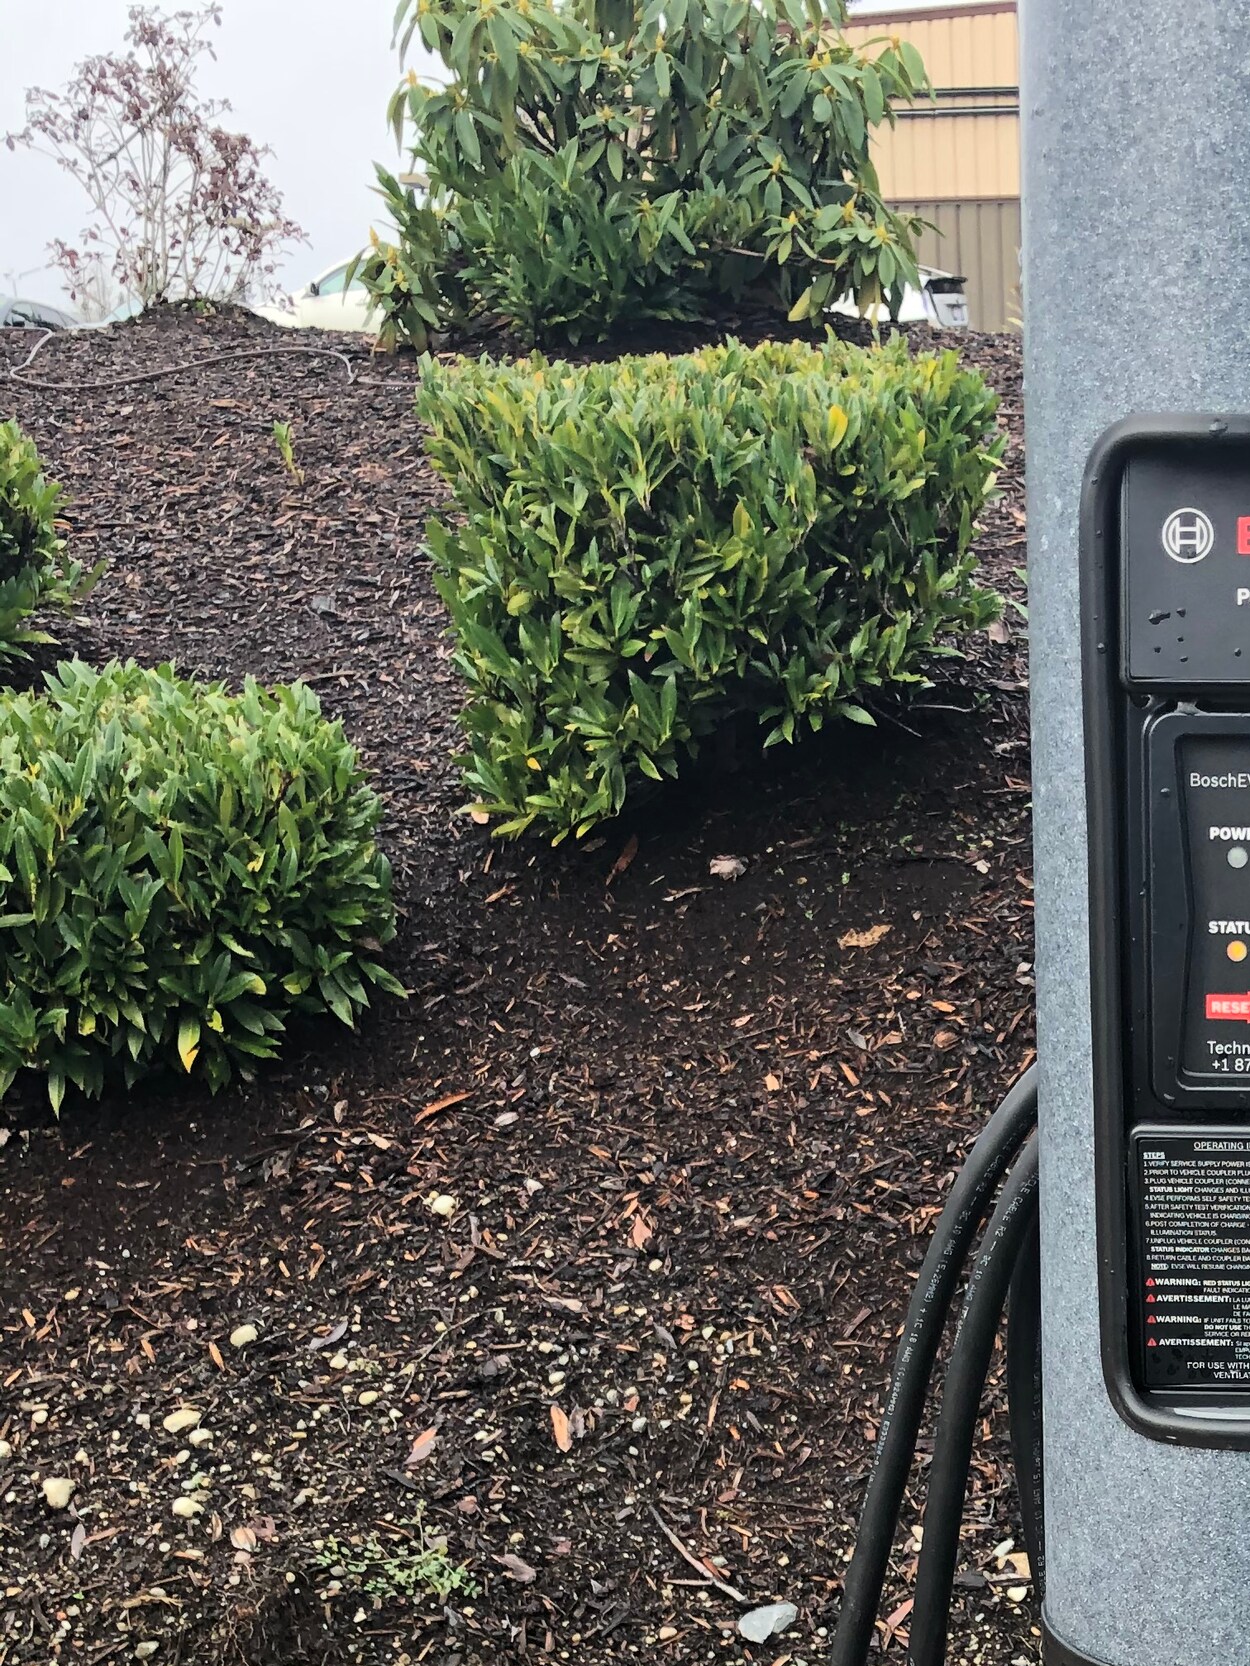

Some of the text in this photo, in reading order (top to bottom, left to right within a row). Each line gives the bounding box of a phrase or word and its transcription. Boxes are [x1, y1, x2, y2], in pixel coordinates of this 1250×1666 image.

[1212, 1058, 1229, 1072] +1
[1194, 1142, 1244, 1150] OPERATING
[1155, 1277, 1201, 1286] WARNING:
[1156, 1294, 1232, 1302] AVERTISSEMENT:
[1156, 1315, 1202, 1323] WARNING:
[1159, 1338, 1234, 1347] AVERTISSEMENT:
[1208, 1361, 1224, 1371] USE
[1227, 1362, 1249, 1371] WITH
